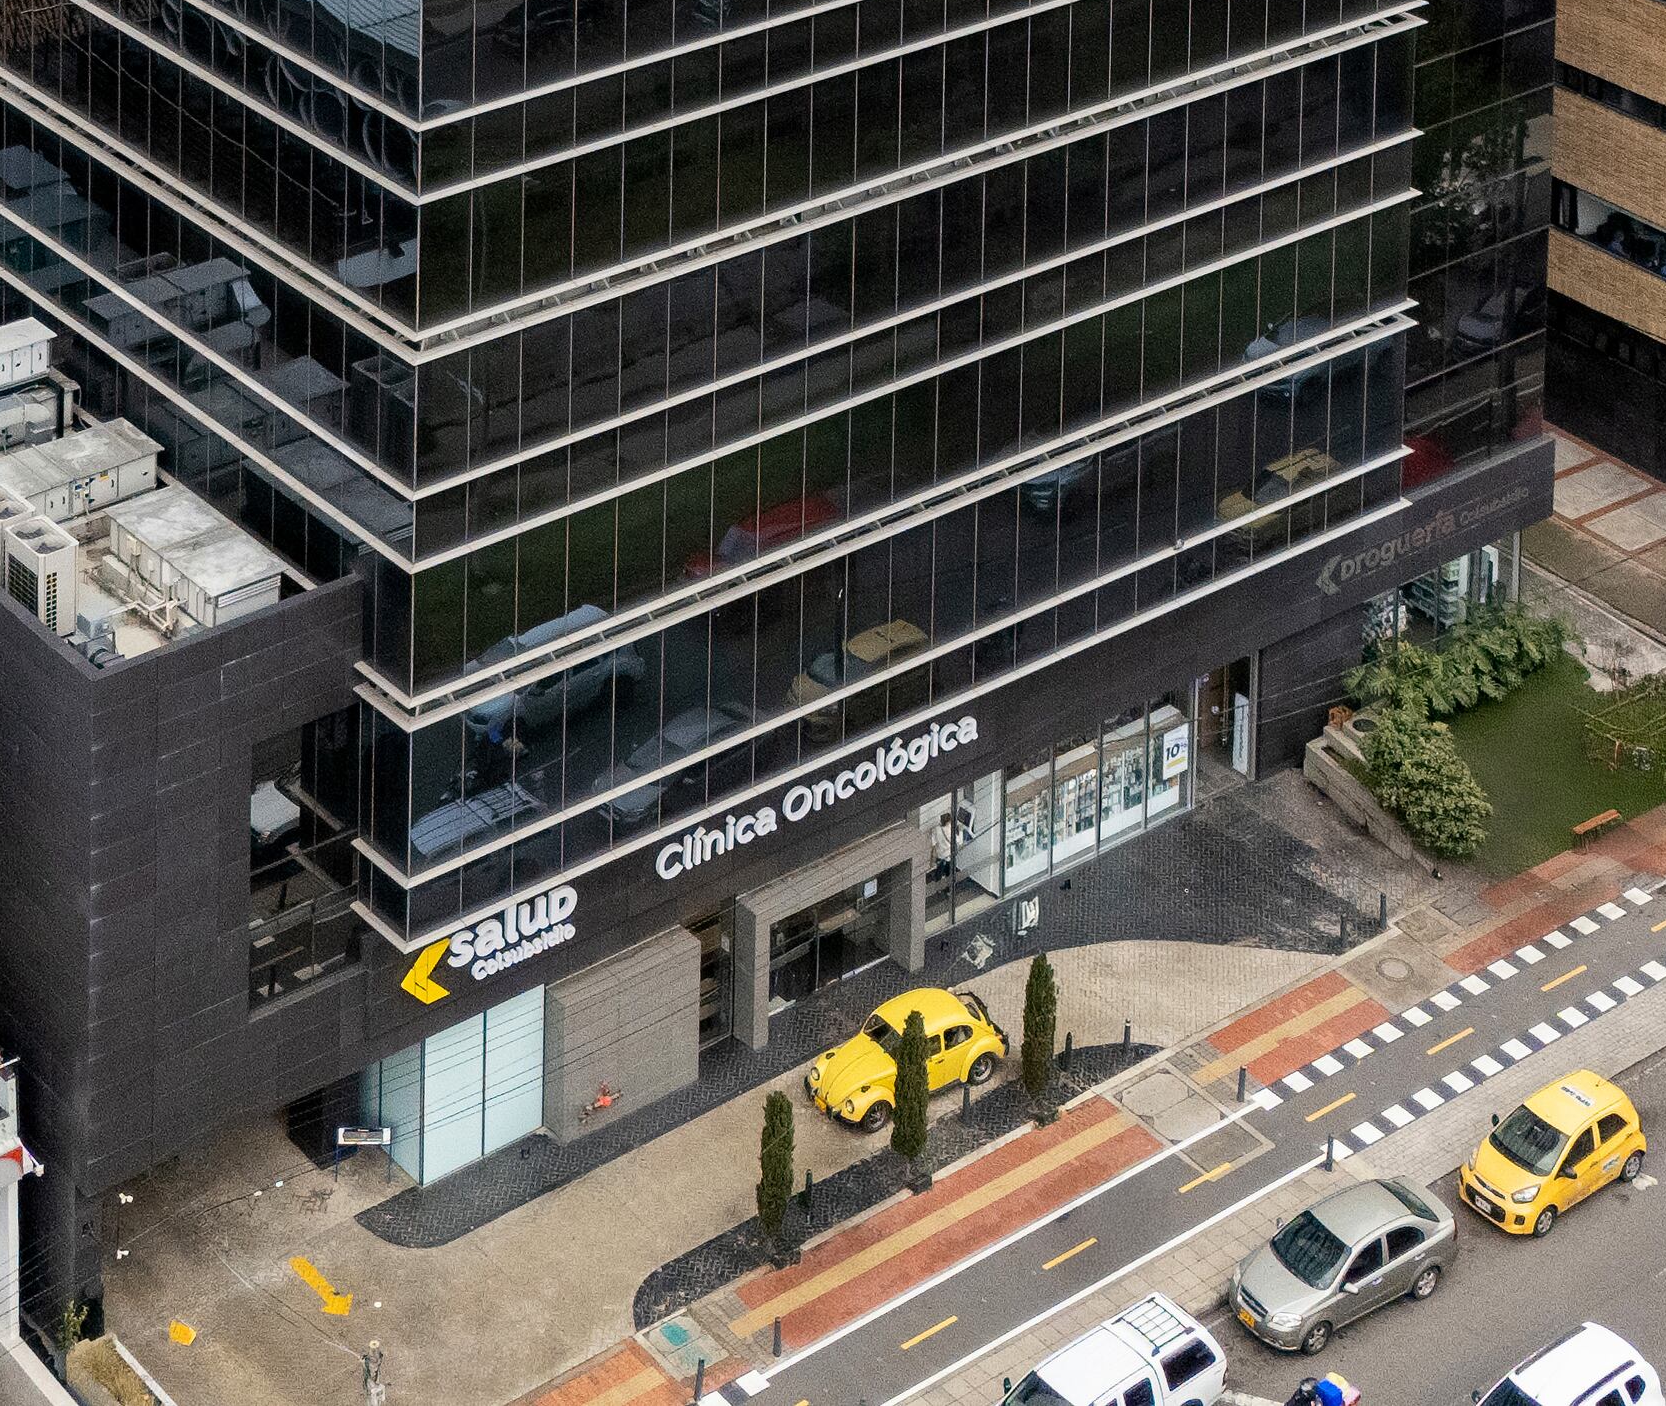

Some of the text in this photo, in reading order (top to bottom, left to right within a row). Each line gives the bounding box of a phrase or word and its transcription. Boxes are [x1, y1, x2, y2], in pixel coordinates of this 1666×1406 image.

[655, 715, 979, 880] Clínica Oncológica
[471, 923, 576, 980] Colsubsidio
